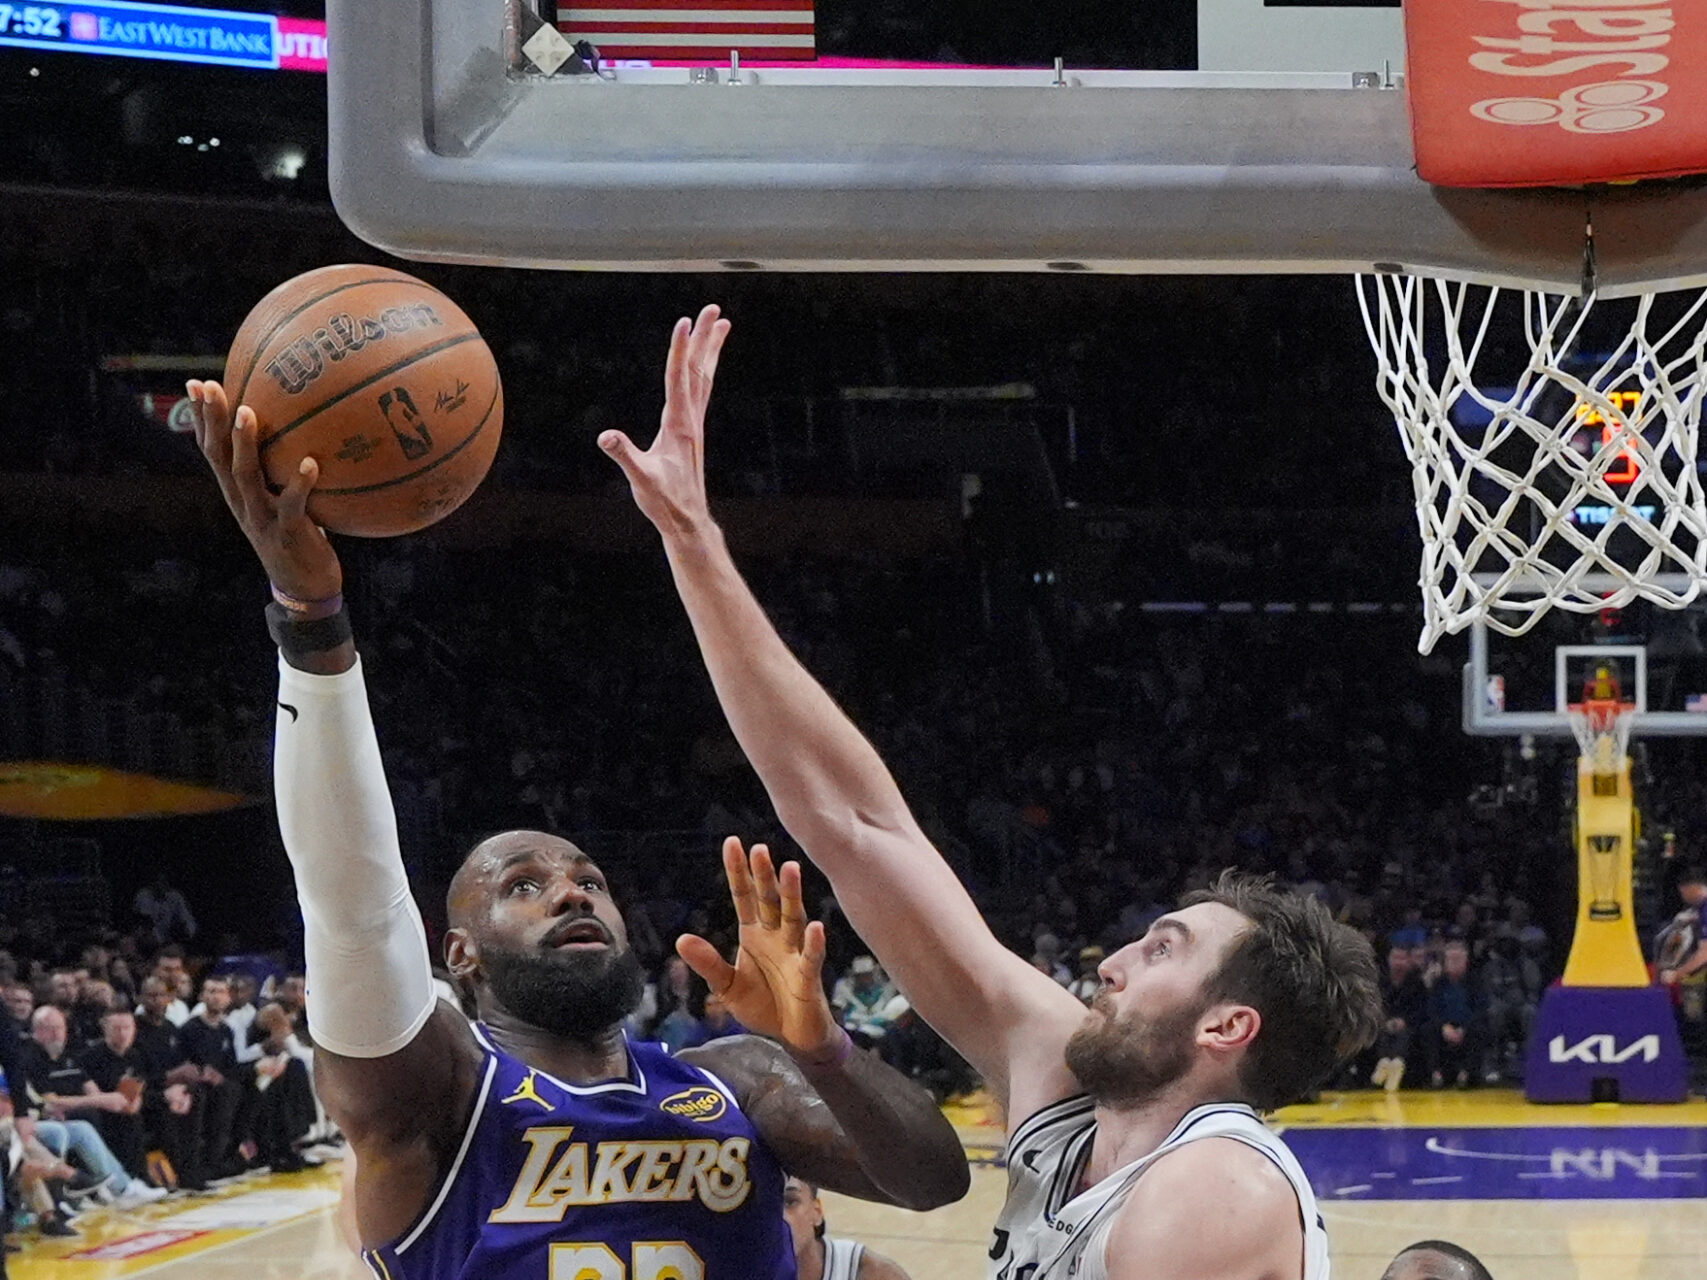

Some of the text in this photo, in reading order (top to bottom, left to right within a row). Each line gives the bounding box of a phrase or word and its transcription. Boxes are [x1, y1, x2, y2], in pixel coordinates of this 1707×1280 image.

[264, 302, 443, 396] Wilson
[1549, 1034, 1659, 1063] KIA
[664, 1094, 719, 1114] bibigo
[487, 1126, 752, 1223] LAKERS
